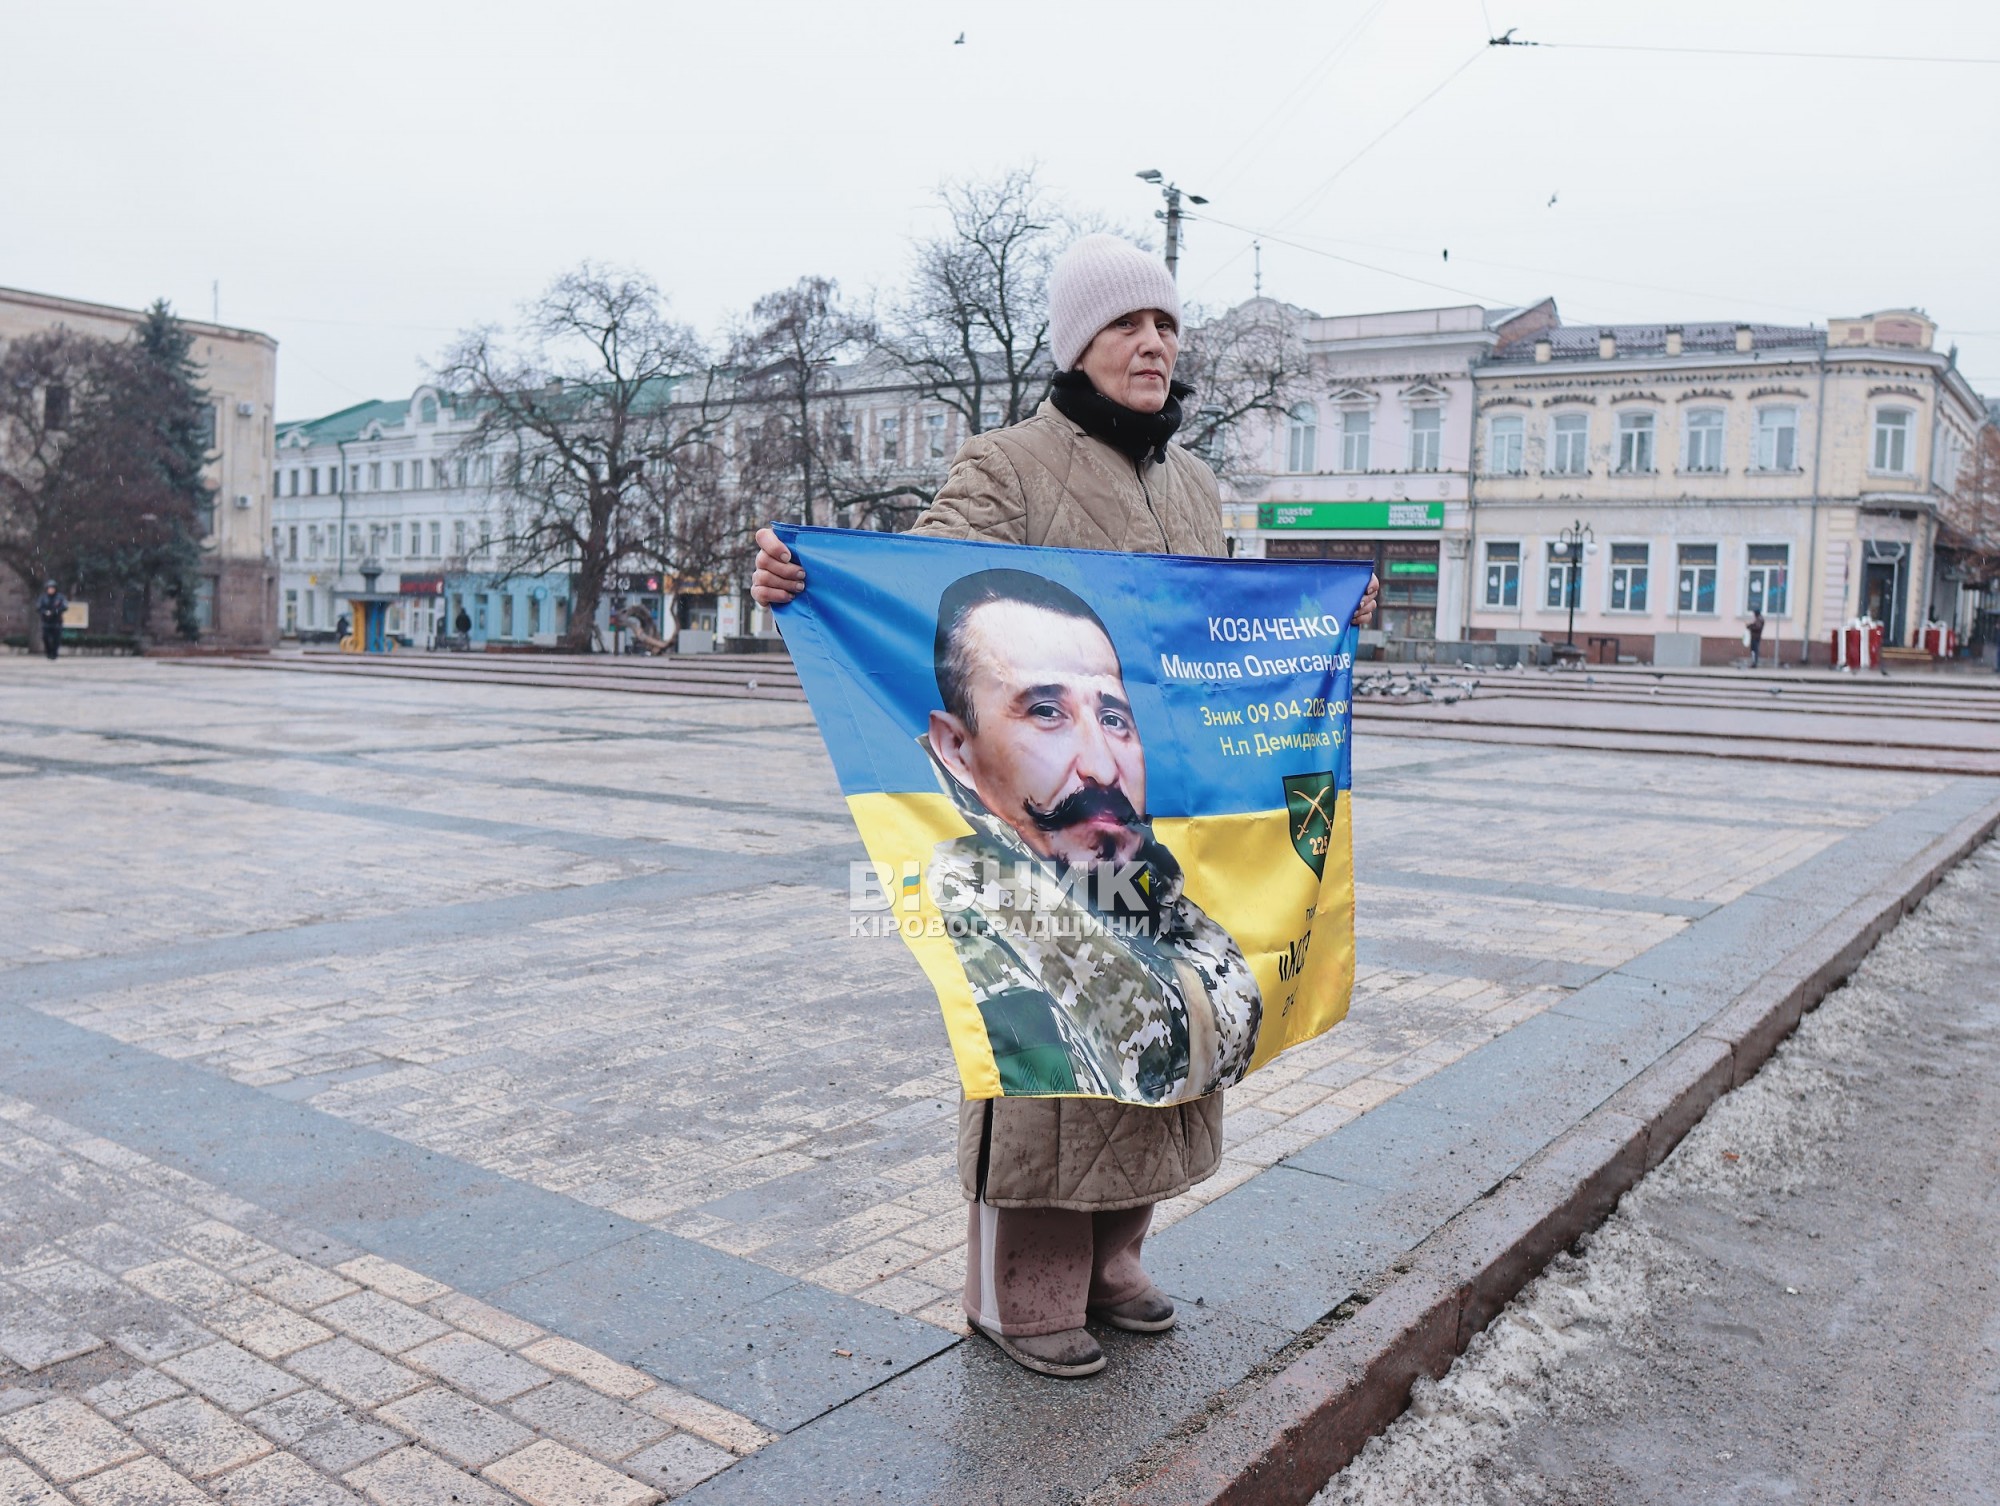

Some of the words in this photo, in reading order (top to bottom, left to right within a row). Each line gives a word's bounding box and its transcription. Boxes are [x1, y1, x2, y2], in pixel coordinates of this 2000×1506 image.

[1277, 506, 1313, 516] master
[1277, 516, 1296, 524] zoo
[1208, 614, 1340, 642] КОЗАЧЕНКО
[1160, 653, 1242, 679] Микола
[1200, 706, 1244, 726] Зник
[1219, 736, 1250, 756] Н.п
[1254, 727, 1330, 757] Демидівка
[1309, 836, 1328, 855] 225
